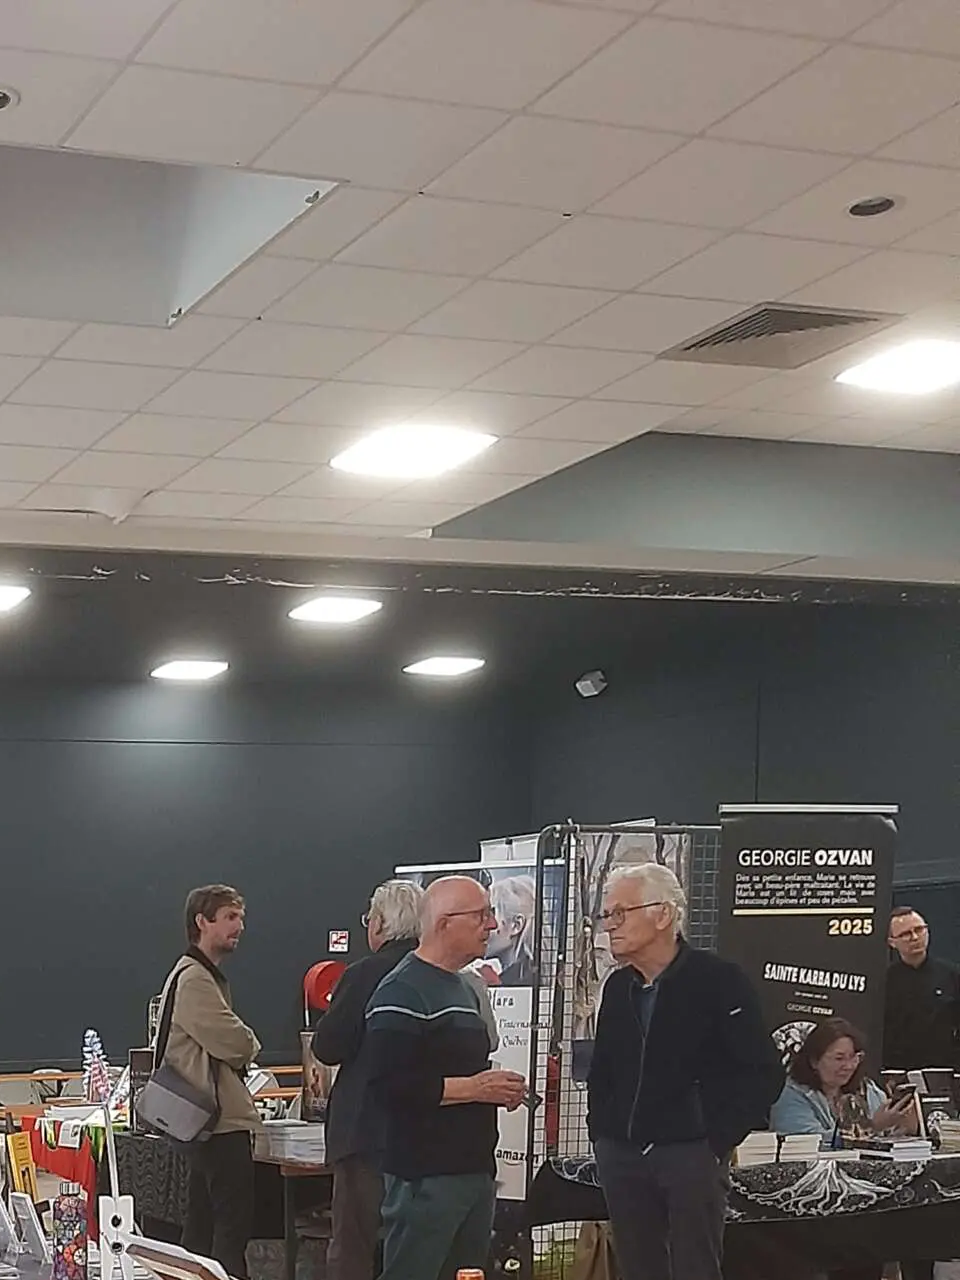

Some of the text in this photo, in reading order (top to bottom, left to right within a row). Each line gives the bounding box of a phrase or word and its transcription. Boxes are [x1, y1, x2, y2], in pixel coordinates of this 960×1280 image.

[738, 849, 873, 866] GEORGIE OZVAN
[828, 918, 873, 935] 2025
[764, 963, 798, 983] SAINTE
[832, 971, 848, 989] DU
[848, 975, 865, 991] LYS
